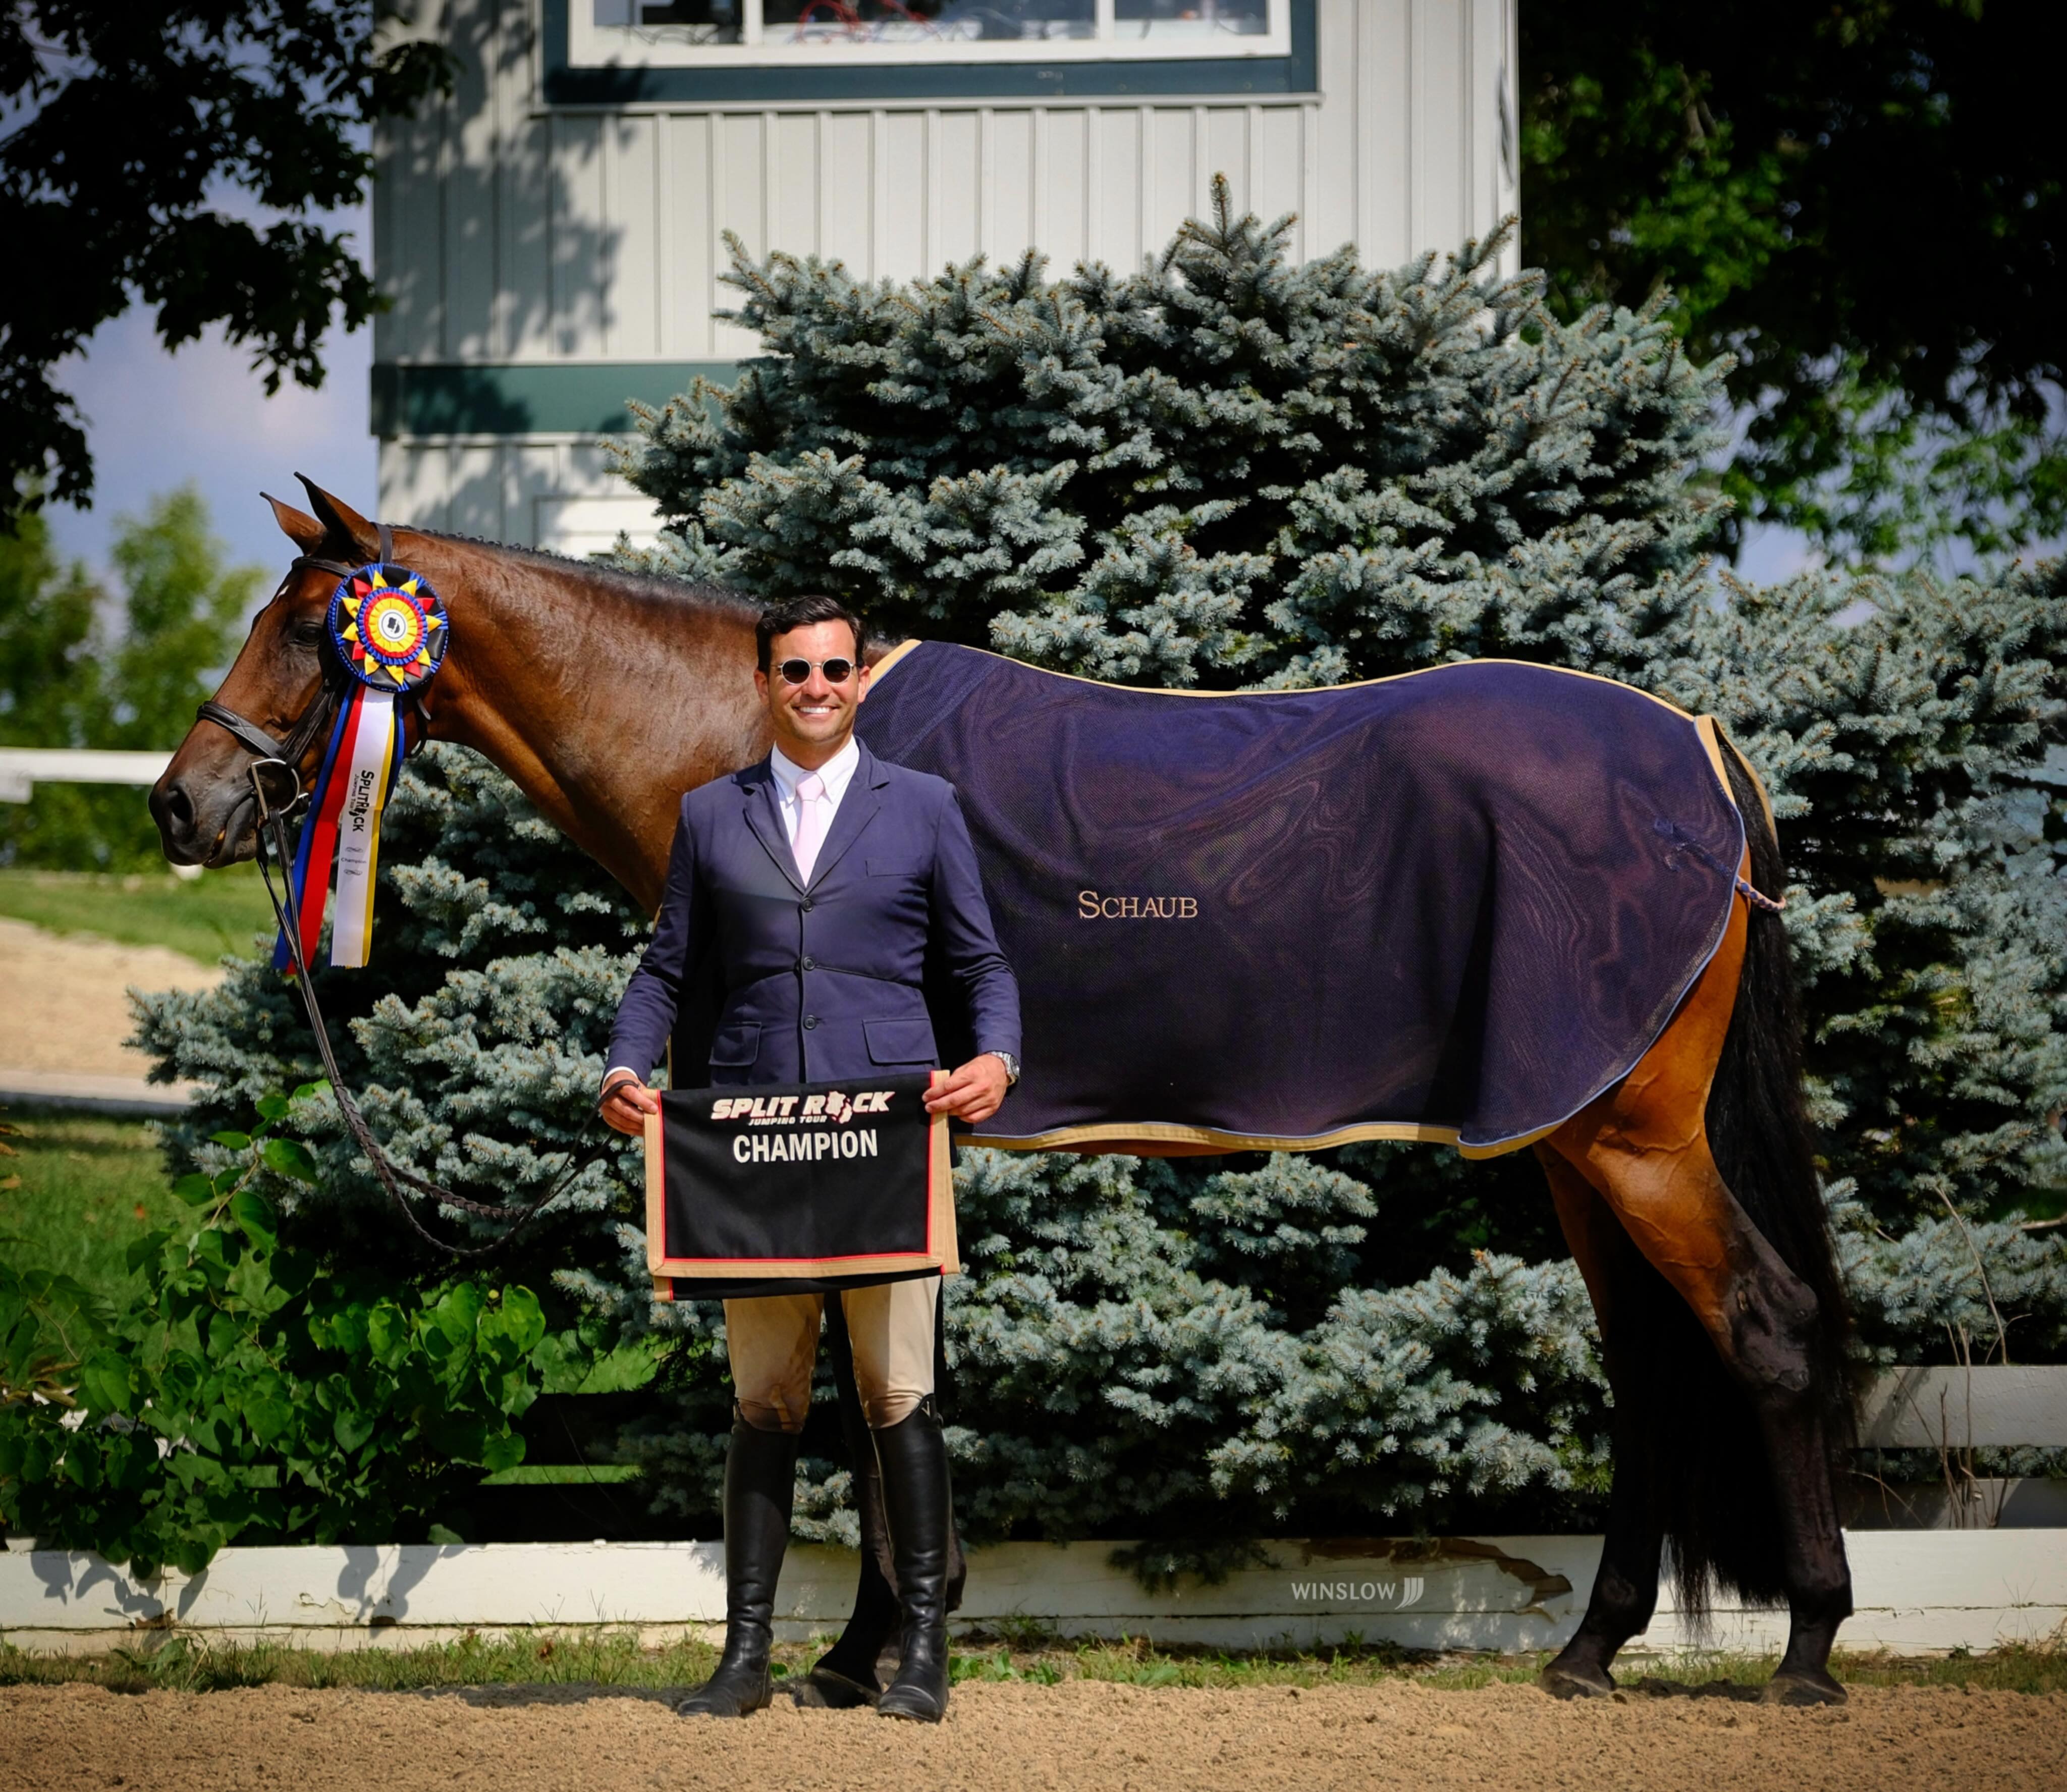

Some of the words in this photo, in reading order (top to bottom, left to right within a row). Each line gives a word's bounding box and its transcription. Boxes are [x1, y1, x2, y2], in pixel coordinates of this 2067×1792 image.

[711, 1096, 799, 1120] SPLIT
[748, 1116, 796, 1126] JUMPING
[799, 1115, 828, 1124] TOUR
[733, 1128, 878, 1163] CHAMPION
